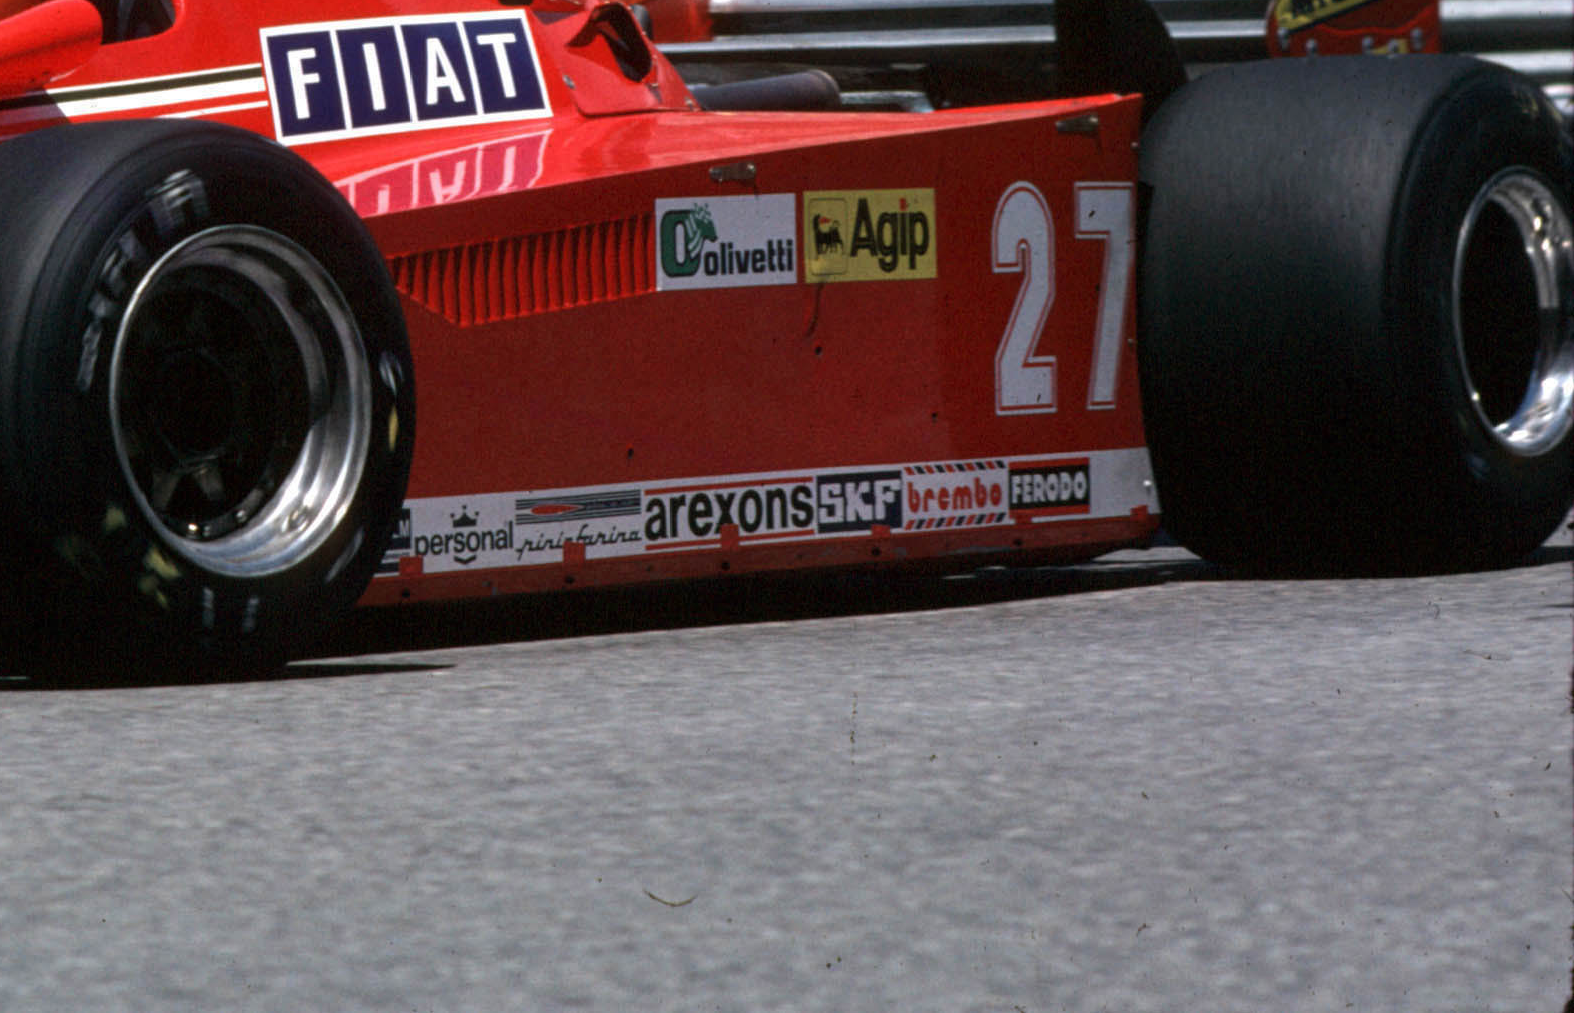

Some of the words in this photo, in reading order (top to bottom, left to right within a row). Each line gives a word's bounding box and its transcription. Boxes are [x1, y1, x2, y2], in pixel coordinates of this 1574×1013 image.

[286, 32, 517, 120] FIAT
[703, 239, 794, 276] olivetti
[850, 197, 930, 273] Agip
[991, 180, 1135, 416] 27
[818, 478, 902, 525] SKF
[907, 477, 1003, 514] brembo
[1010, 470, 1086, 505] FERODO
[644, 484, 815, 542] arexons
[414, 520, 514, 556] personal
